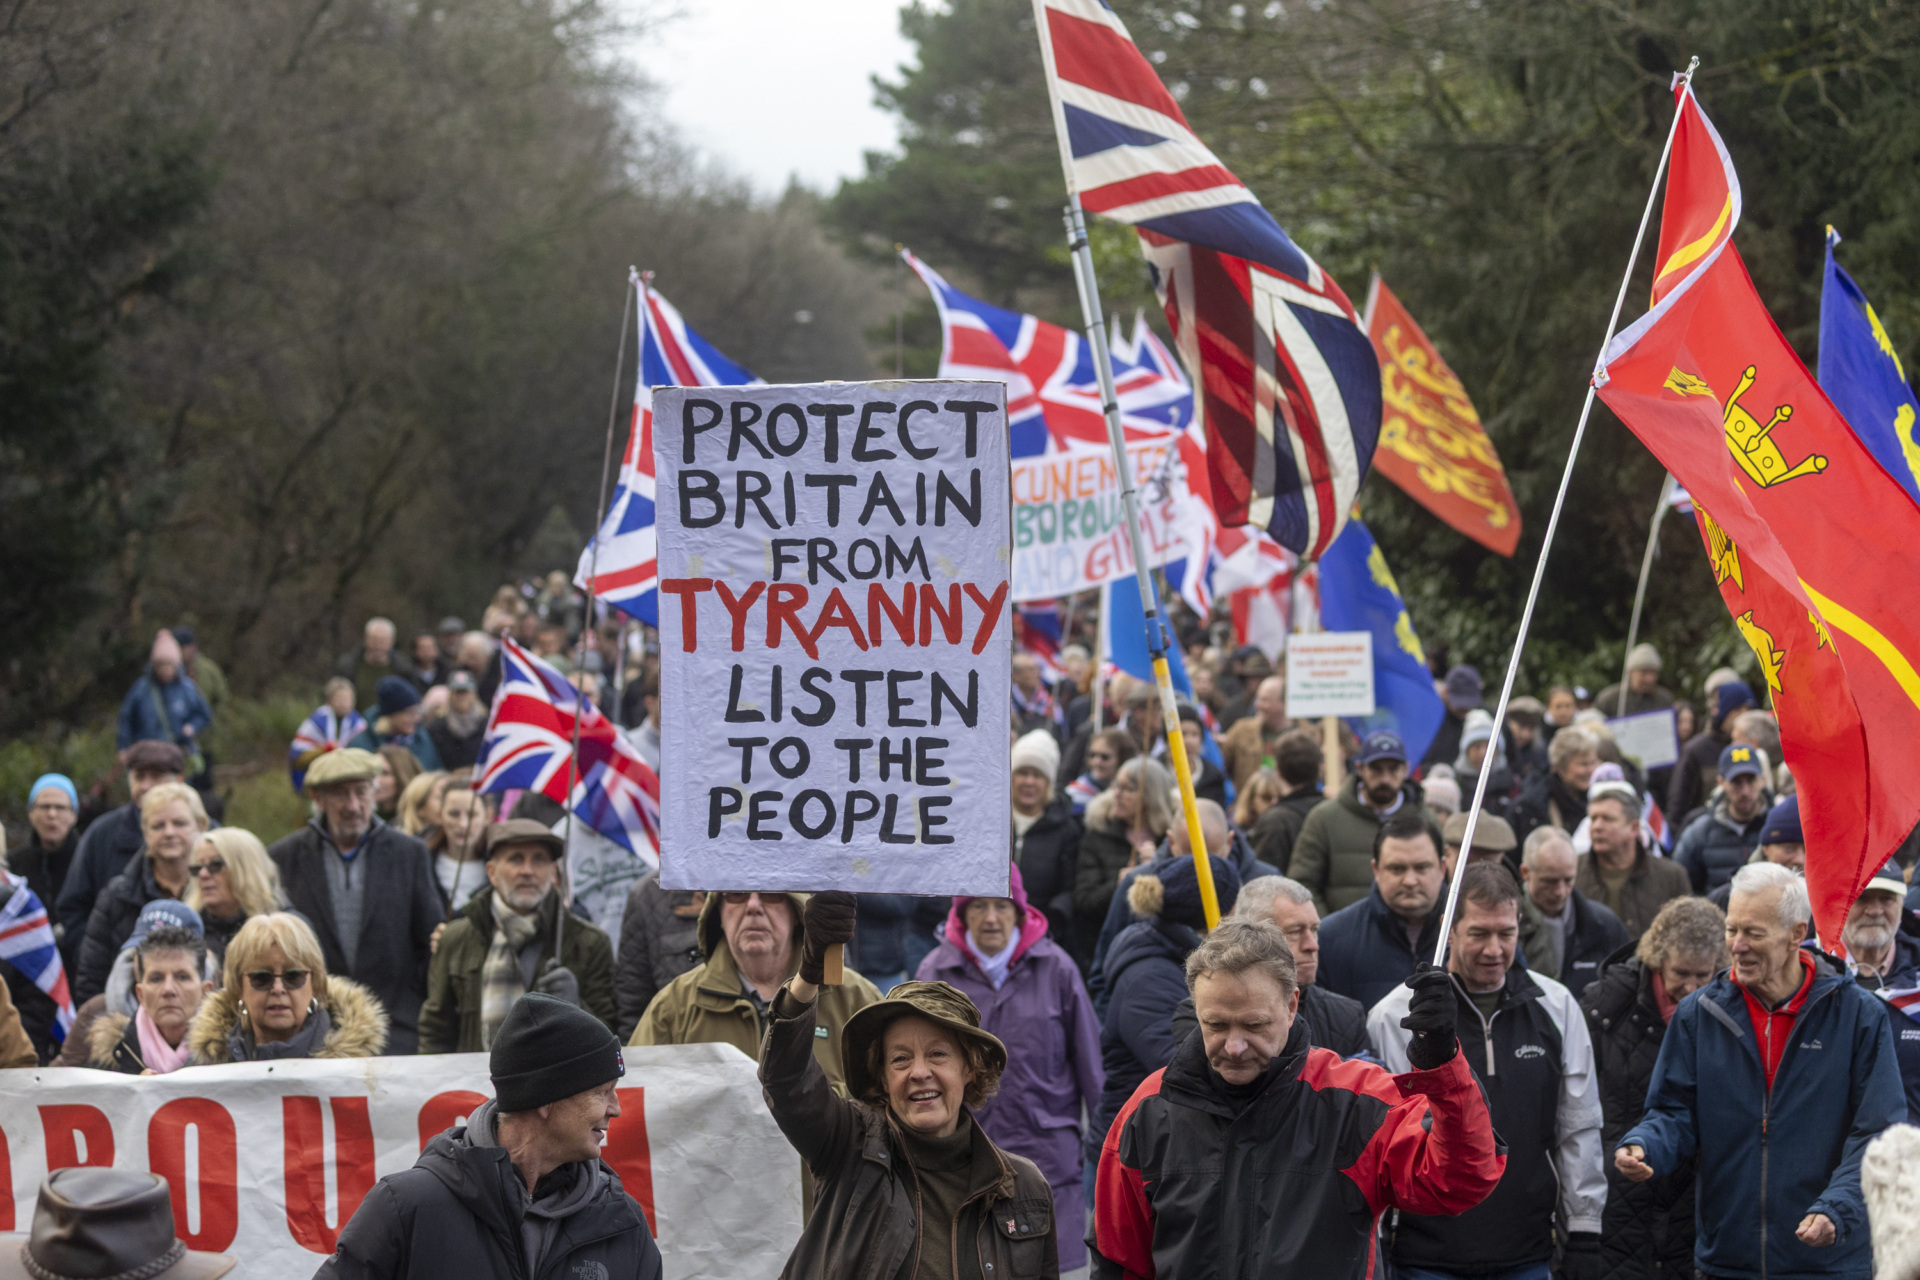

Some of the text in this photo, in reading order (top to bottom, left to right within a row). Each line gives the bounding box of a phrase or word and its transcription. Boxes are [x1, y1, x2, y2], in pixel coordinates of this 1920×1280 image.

[683, 399, 998, 464] PROTECT
[678, 468, 981, 529] BRITAIN
[771, 535, 931, 585] FROM
[661, 578, 1009, 661] TYRANNY
[725, 664, 978, 728] LISTEN
[728, 737, 950, 786] TO THE
[708, 787, 954, 844] PEOPLE
[572, 1266, 600, 1275] NORTH
[583, 1259, 598, 1268] THE
